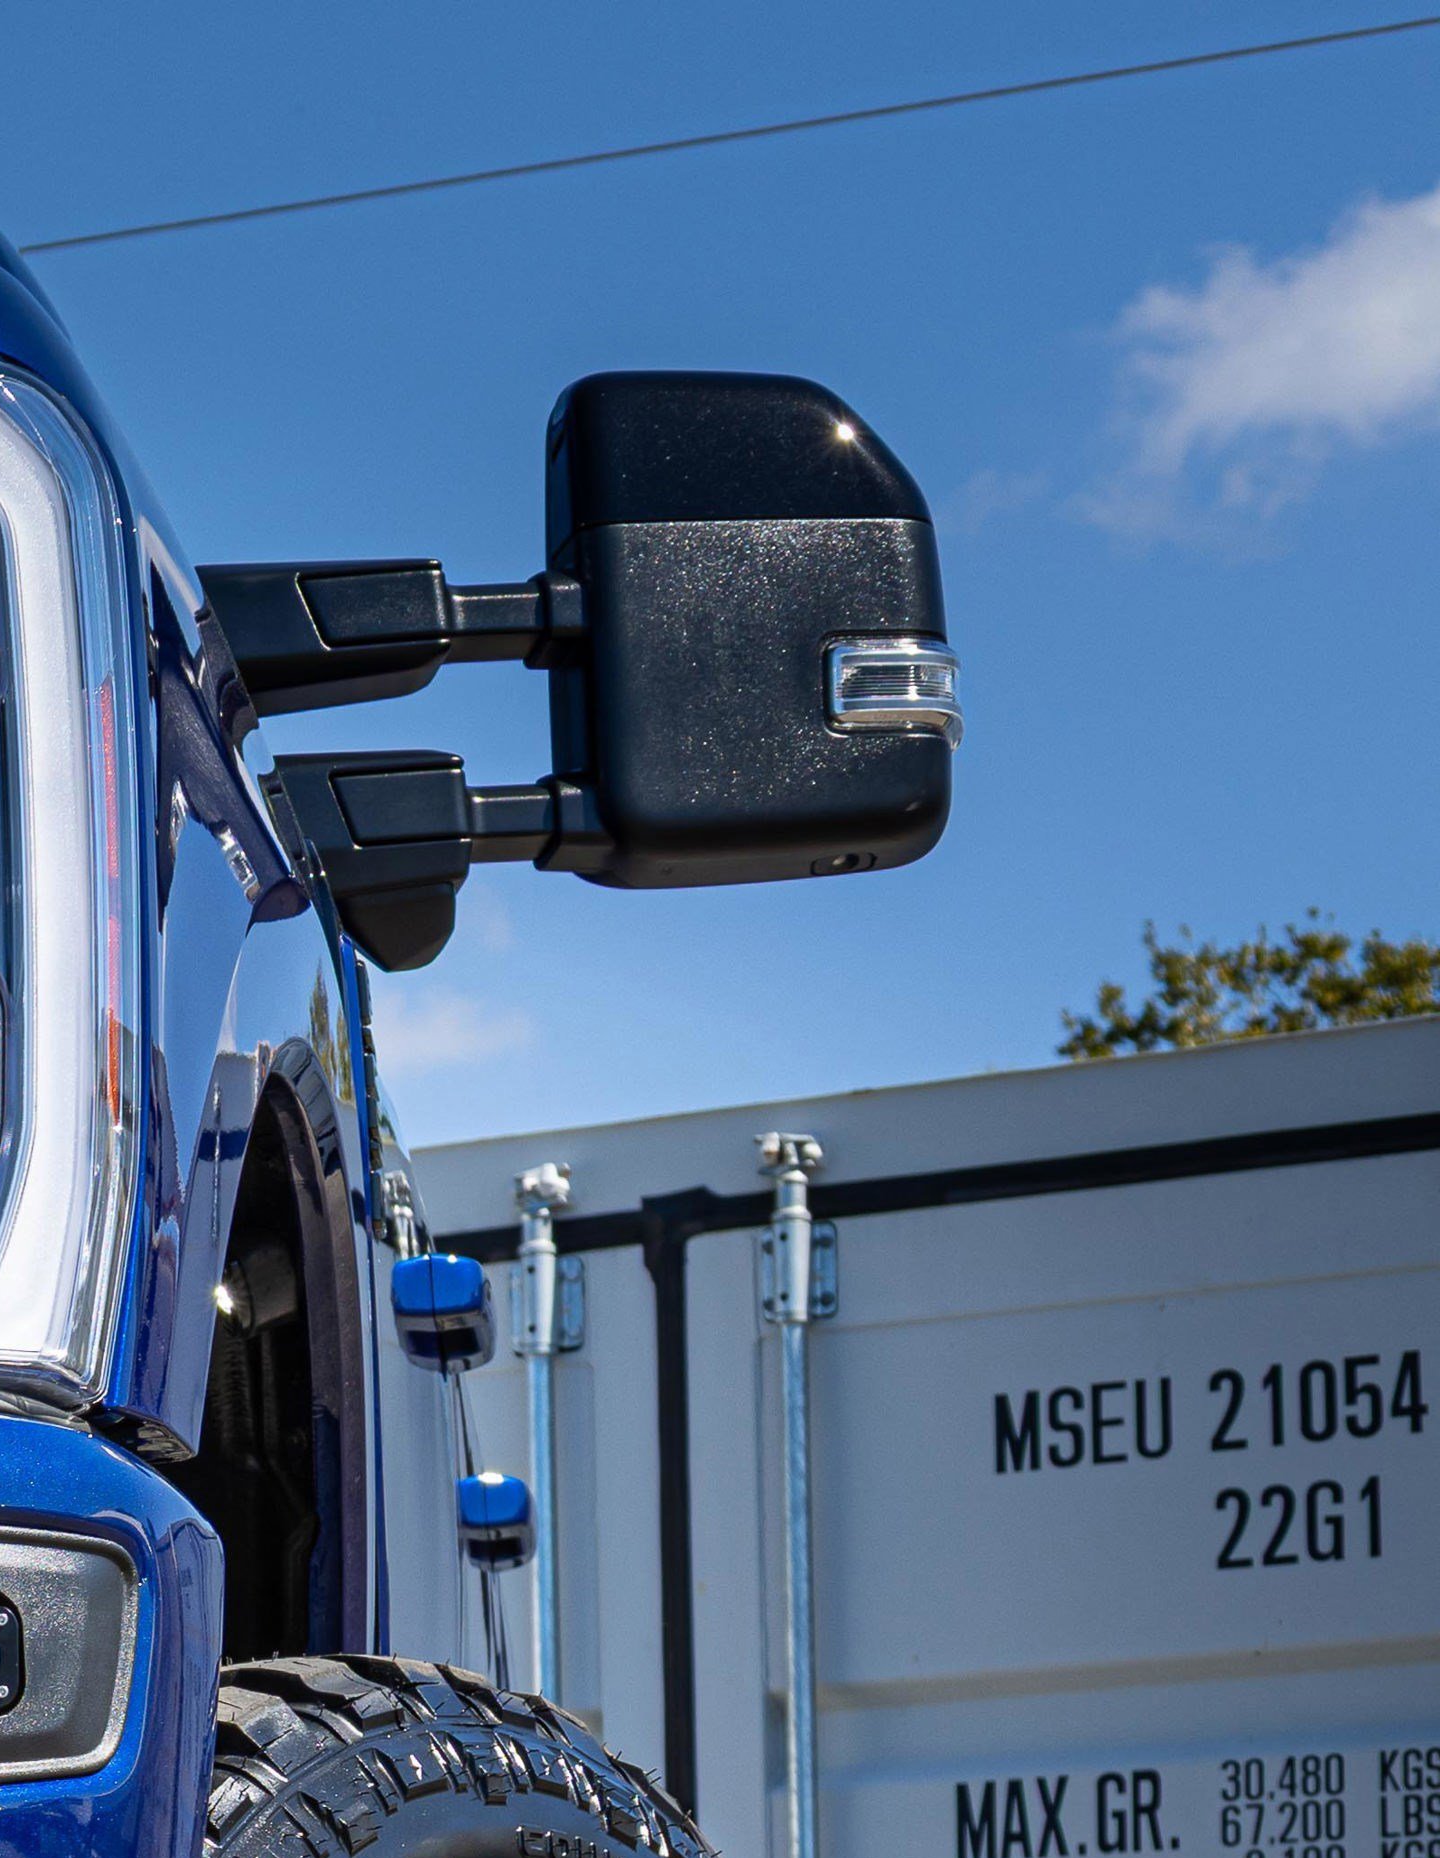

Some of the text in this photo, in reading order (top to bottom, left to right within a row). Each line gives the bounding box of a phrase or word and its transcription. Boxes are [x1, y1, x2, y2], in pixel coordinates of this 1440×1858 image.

[995, 1350, 1428, 1473] MSEU 21054
[1215, 1476, 1381, 1569] 22G1
[1221, 1753, 1344, 1801] 30.480
[1380, 1747, 1440, 1792] KGS
[1221, 1793, 1440, 1847] 67.200 LBS
